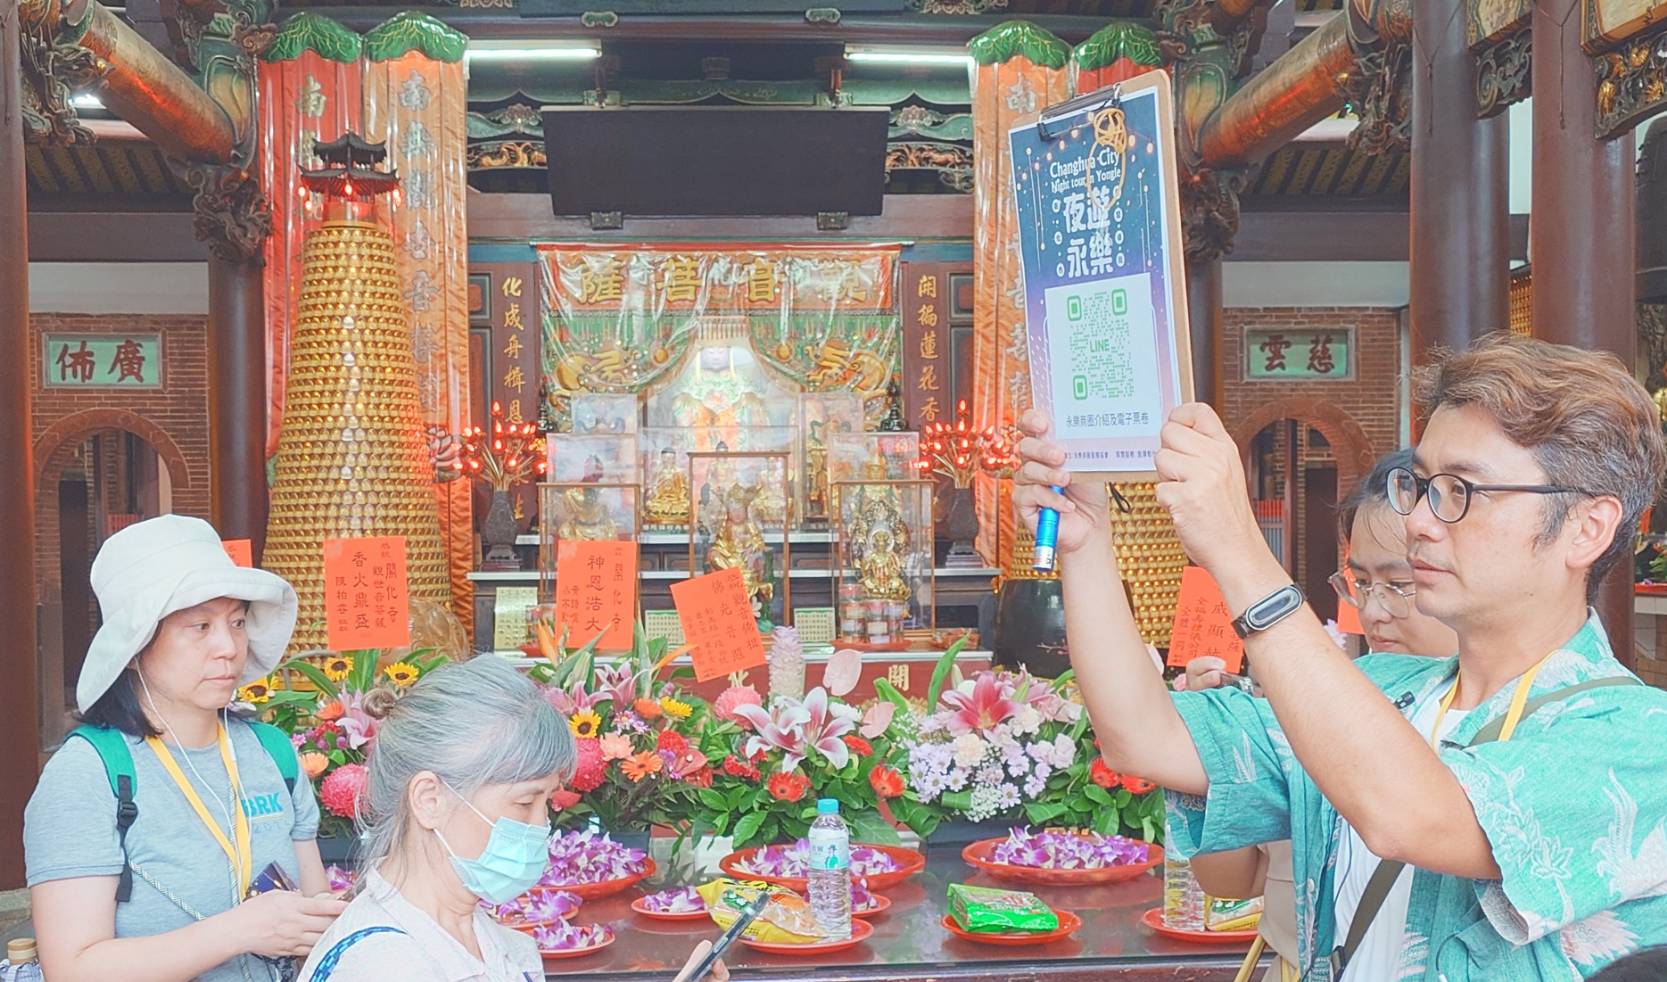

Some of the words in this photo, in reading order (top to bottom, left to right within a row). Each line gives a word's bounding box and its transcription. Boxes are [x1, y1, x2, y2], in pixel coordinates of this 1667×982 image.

[1099, 147, 1120, 167] City
[1051, 178, 1070, 193] Night
[1063, 186, 1111, 234] 夜遊
[1067, 232, 1114, 278] 永樂
[1089, 338, 1110, 353] LINE
[352, 551, 370, 630] 香火鼎盛
[585, 554, 605, 632] 神恩浩大
